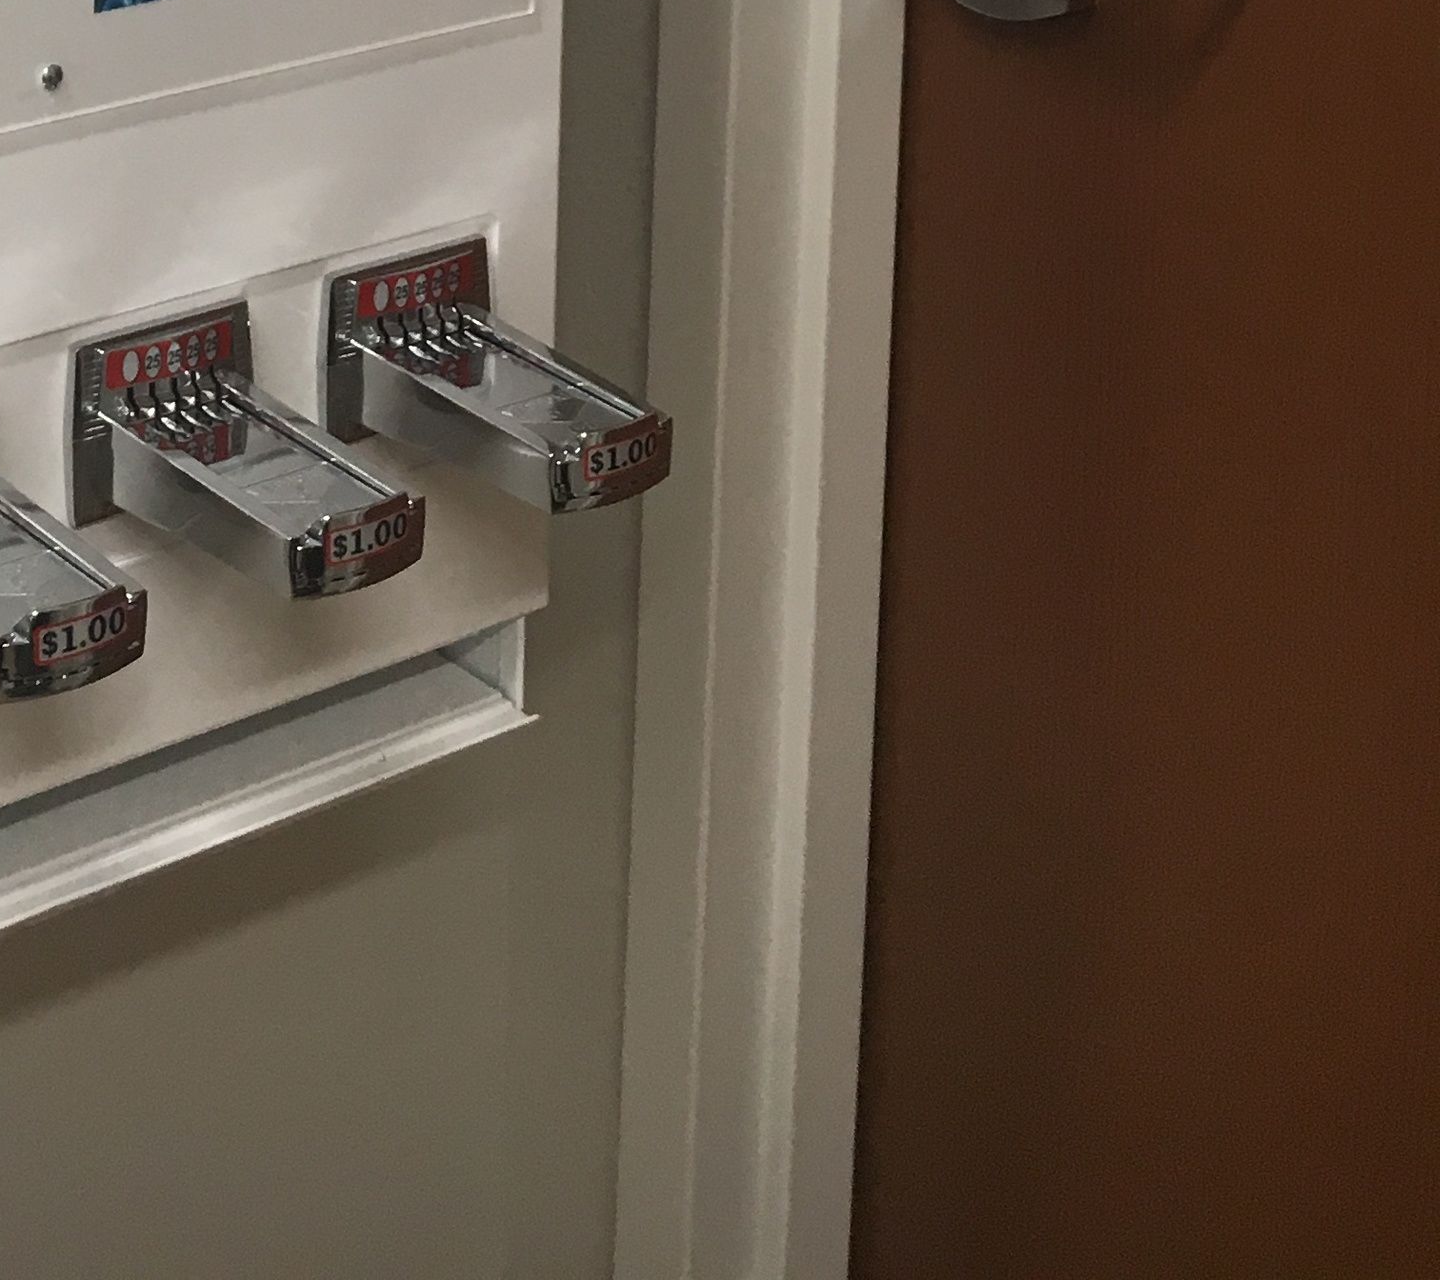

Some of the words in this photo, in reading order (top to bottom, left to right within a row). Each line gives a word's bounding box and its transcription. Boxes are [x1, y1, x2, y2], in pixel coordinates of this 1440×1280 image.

[146, 353, 161, 370] 25
[169, 349, 182, 366] 25
[188, 342, 200, 359] 25
[589, 431, 657, 475] $1.00
[332, 511, 408, 560] $1.00
[41, 605, 126, 658] $1.00
